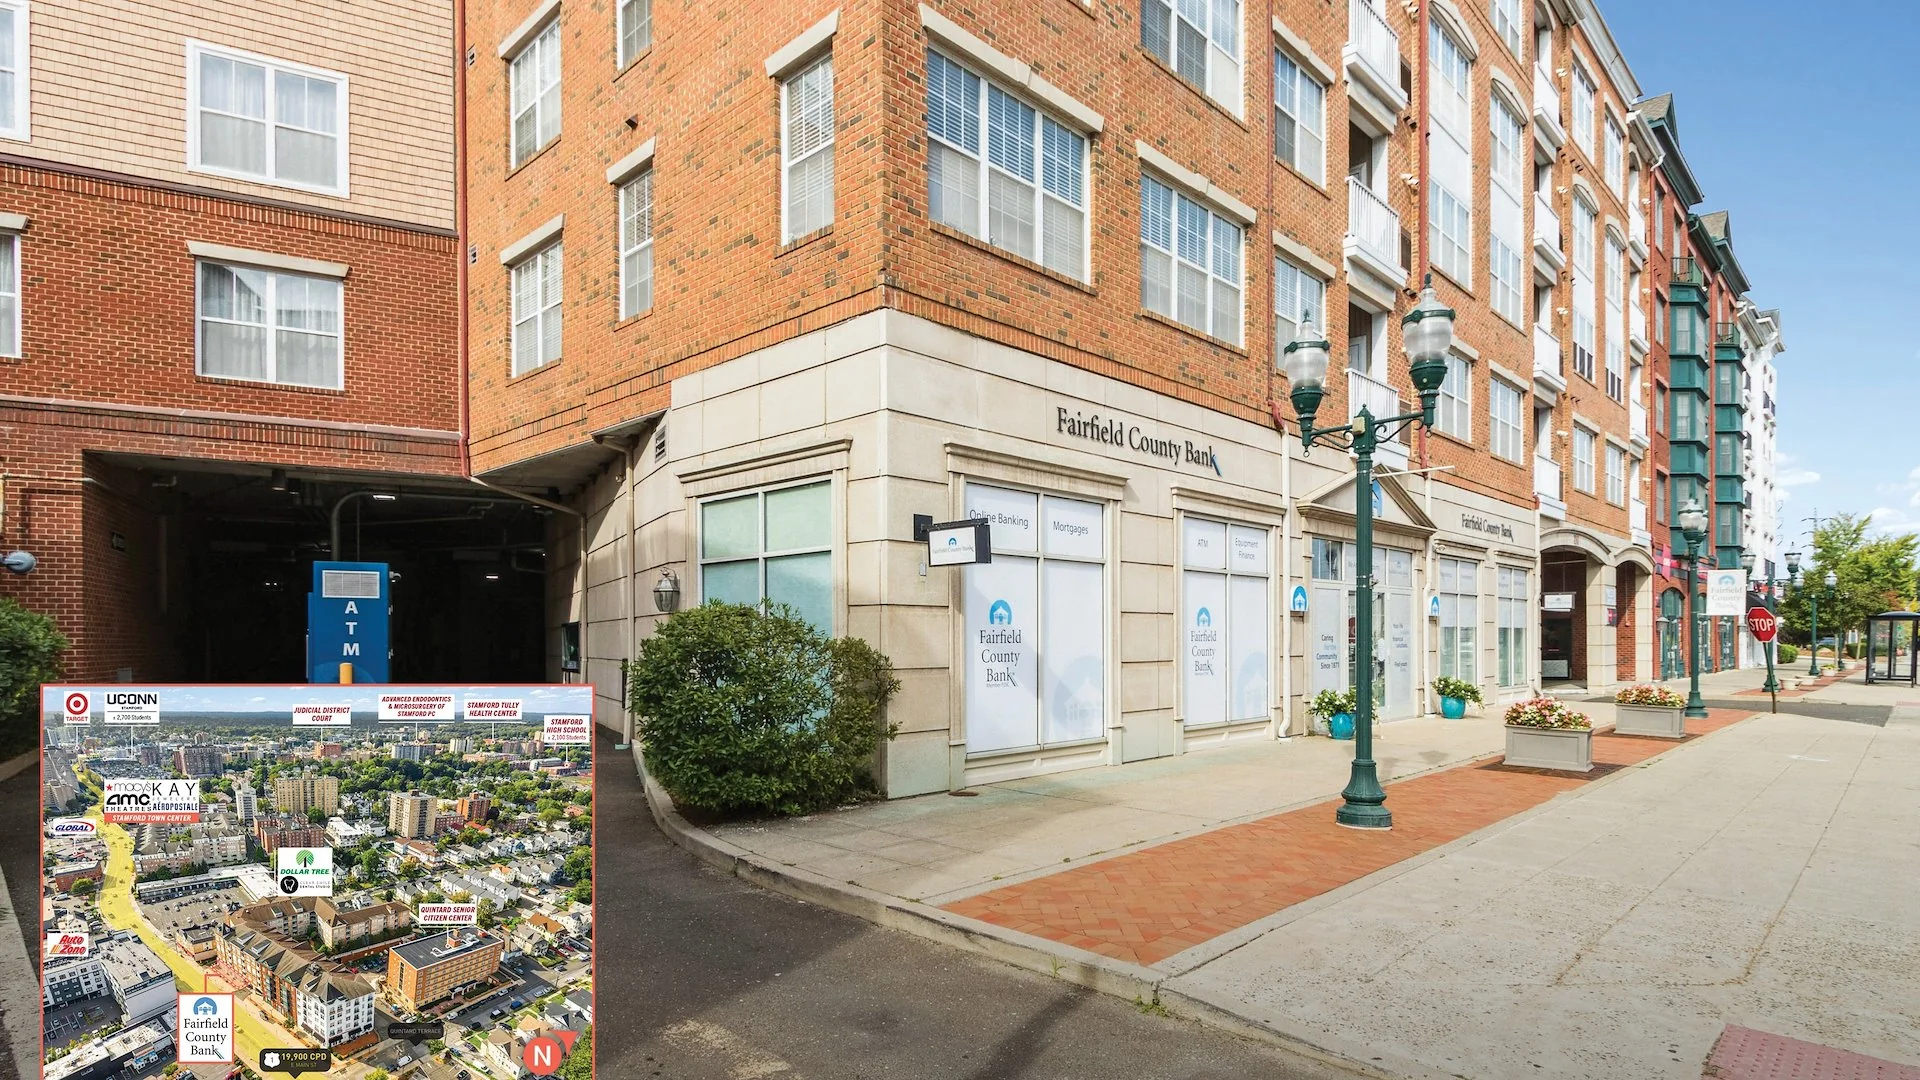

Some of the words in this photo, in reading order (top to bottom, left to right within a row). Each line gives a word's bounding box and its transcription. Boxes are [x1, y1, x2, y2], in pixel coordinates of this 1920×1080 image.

[1056, 406, 1124, 447] Fairfield
[1129, 426, 1182, 465] County
[1184, 440, 1223, 477] Bank
[970, 509, 996, 523] Online
[998, 513, 1029, 529] Banking
[1053, 521, 1089, 536] Mortgages
[1461, 513, 1483, 532] Fairfield
[1482, 519, 1501, 538] County
[1501, 524, 1514, 543] Bank
[1197, 538, 1209, 548] ATM
[1235, 537, 1259, 549] Equipment
[1238, 550, 1255, 560] Finance
[343, 601, 360, 656] ATM
[1749, 618, 1774, 632] STOP
[980, 629, 1022, 644] Fairfield
[1190, 630, 1217, 642] Fairfield
[1321, 634, 1334, 642] Caring
[981, 648, 1021, 667] County
[1191, 645, 1216, 660] County
[1316, 653, 1338, 661] Community
[1194, 660, 1214, 676] Bank
[986, 667, 1018, 687] Bank
